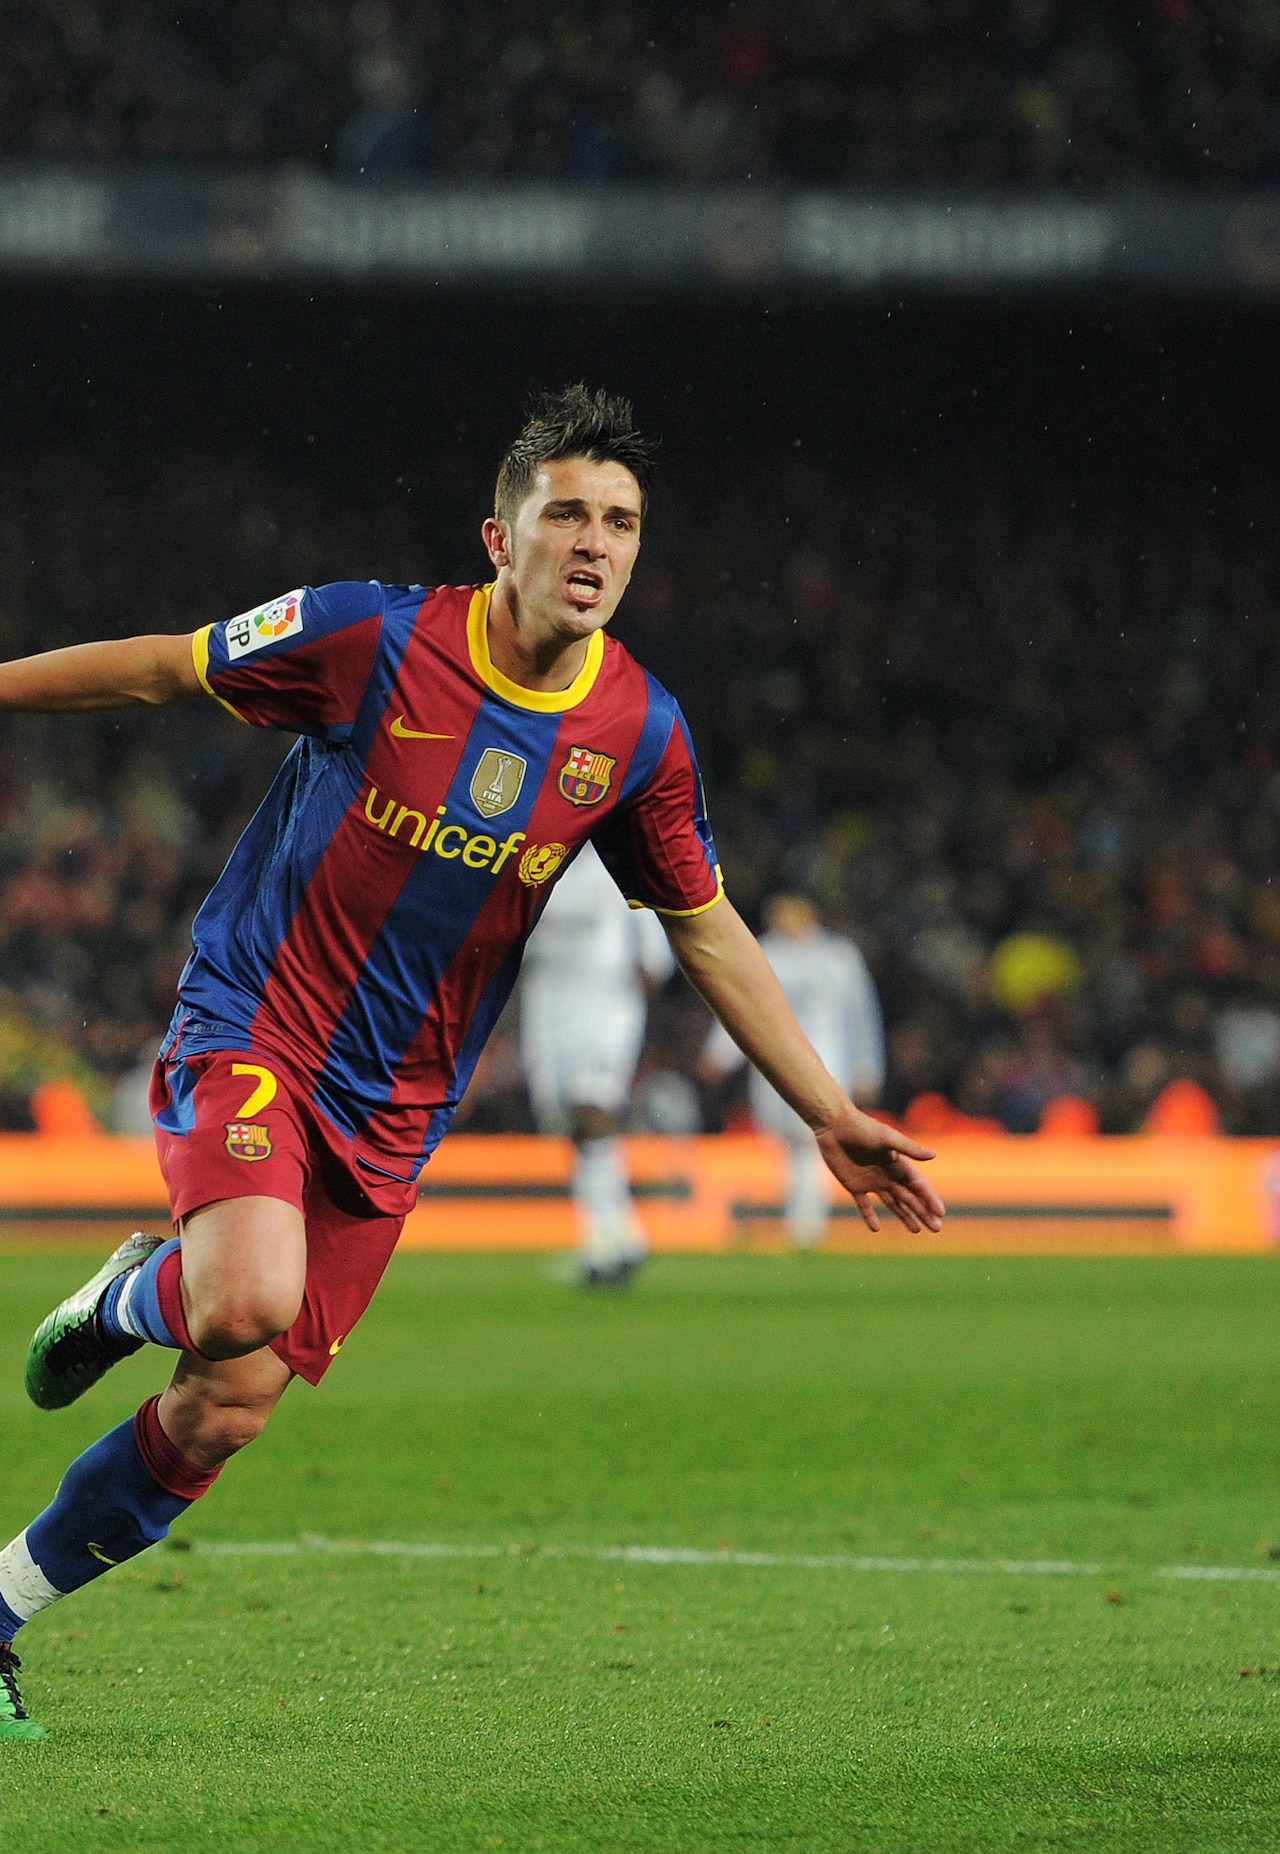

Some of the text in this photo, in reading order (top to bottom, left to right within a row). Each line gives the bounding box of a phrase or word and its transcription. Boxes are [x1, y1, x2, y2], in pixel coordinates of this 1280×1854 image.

[483, 790, 502, 803] FIFA
[364, 786, 526, 875] unicef
[232, 1063, 277, 1119] 7
